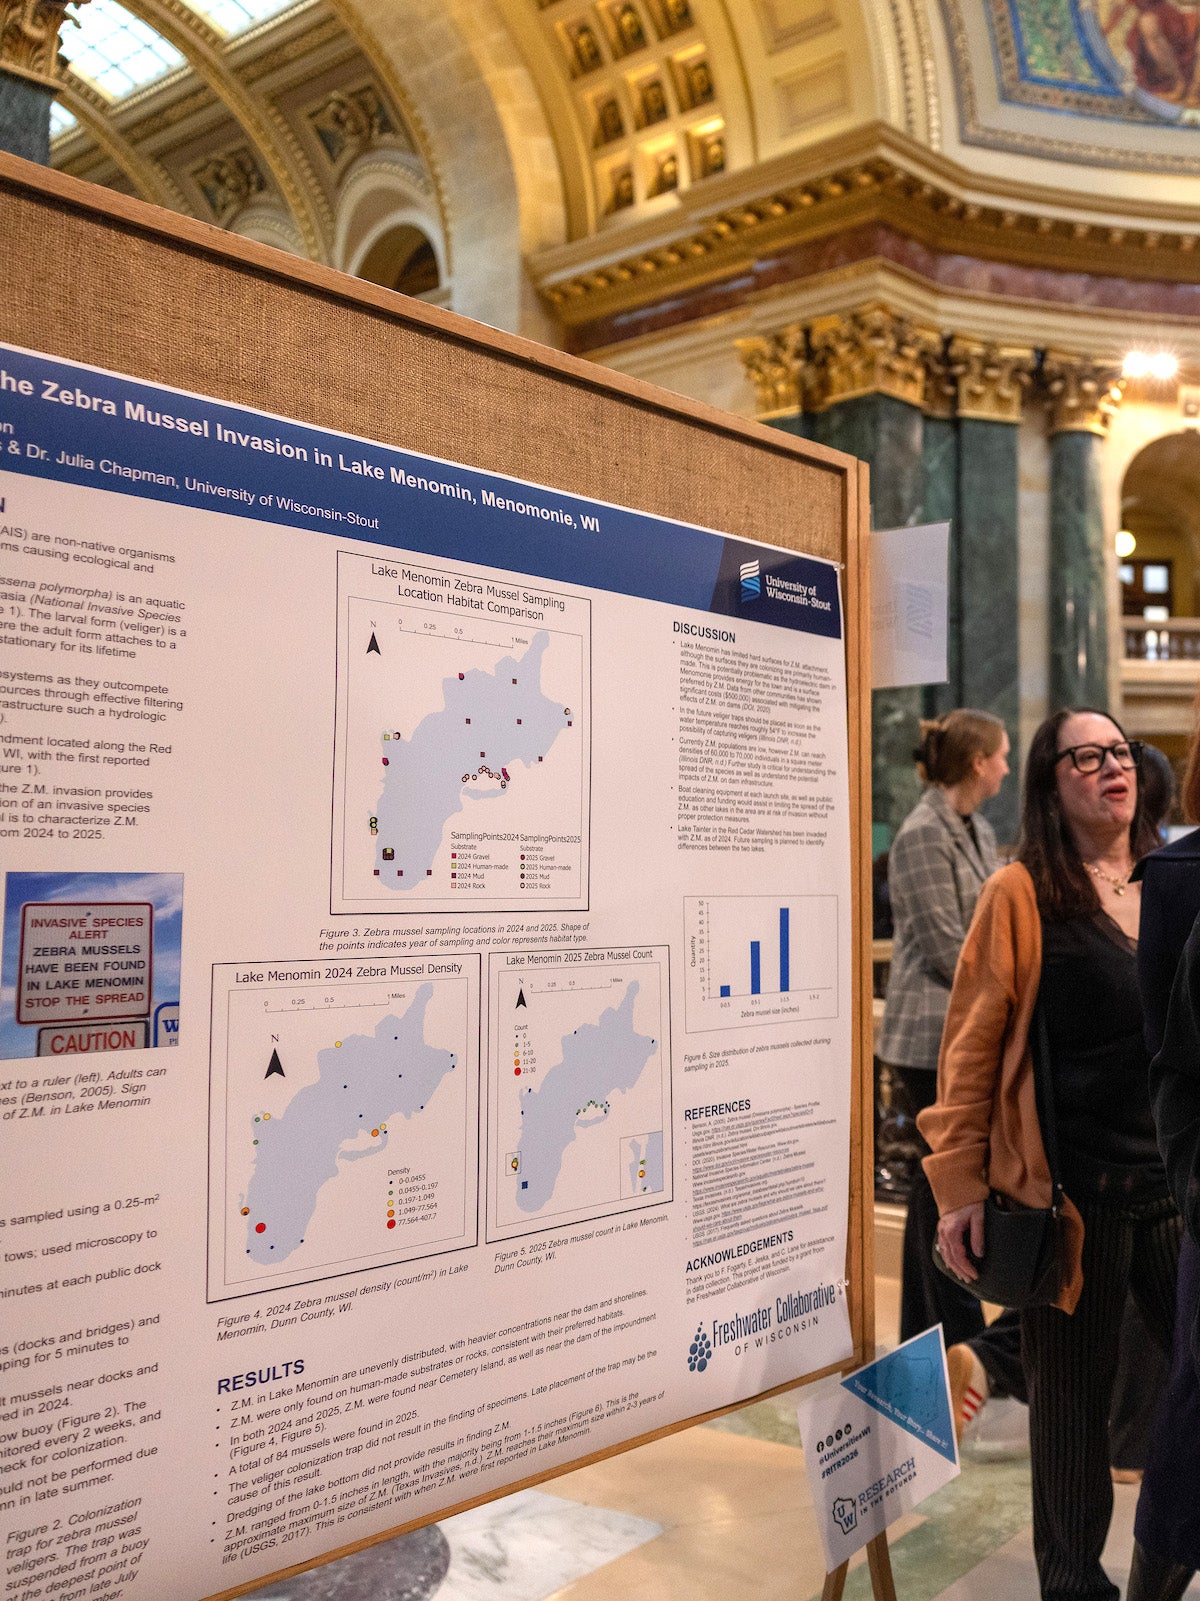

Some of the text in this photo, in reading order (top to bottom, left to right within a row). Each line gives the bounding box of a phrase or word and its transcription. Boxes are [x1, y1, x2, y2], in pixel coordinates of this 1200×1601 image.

[0, 370, 600, 532] he Zebra Mussel Invasion in Lake Menomin, Menomonie, WI
[8, 440, 379, 530] & Dr. Julia Chapman, University of Wisconsin-Stout
[23, 545, 154, 573] causing ecological and
[32, 533, 175, 563] are non-native organisms
[371, 563, 565, 612] Lake Menomin Zebra Mussel Sampling
[765, 575, 816, 595] University of
[398, 585, 544, 621] Location Habitat Comparison
[766, 587, 831, 611] Wisconsin-Stout
[673, 621, 736, 643] DISCUSSION
[451, 832, 519, 842] SamplingPoints2024
[520, 833, 581, 844] SamplingPoints2025
[31, 918, 143, 928] INVASIVE SPECIES
[69, 930, 108, 939] ALERT
[319, 929, 349, 940] Figure
[351, 928, 360, 937] 3.
[364, 927, 390, 937] Zebra
[392, 926, 423, 936] mussel
[425, 926, 461, 936] sampling
[462, 925, 496, 934] locations
[526, 924, 539, 932] and
[541, 923, 558, 932] 2025.
[561, 923, 580, 932] Shape
[582, 922, 590, 930] of
[33, 945, 140, 957] ZEBRA MUSSELS
[319, 941, 335, 951] the
[337, 940, 365, 951] points
[368, 939, 407, 948] indicates
[409, 939, 427, 949] year
[428, 938, 438, 946] of
[440, 937, 474, 948] sampling
[476, 937, 491, 945] and
[511, 935, 547, 945] represents
[550, 934, 571, 942] habitat
[573, 934, 588, 943] type.
[26, 961, 145, 973] HAVE BEEN FOUND
[506, 950, 653, 965] Lake Menomin 2025 Zebra Mussel Count
[27, 977, 144, 990] IN LAKE MENOMIN
[236, 963, 462, 983] Lake Menomin 2024 Zebra Mussel Density
[25, 993, 144, 1008] STOP THE SPREAD
[51, 1030, 135, 1054] CAUTION
[684, 1099, 750, 1121] REFERENCES
[387, 1167, 410, 1177] Density
[686, 1231, 793, 1273] ACKNOWLEDGEMENTS
[217, 1313, 250, 1327] Figure
[254, 1310, 263, 1318] 4.
[267, 1303, 291, 1317] 2024
[294, 1298, 322, 1311] Zebra
[324, 1289, 358, 1304] mussel
[360, 1281, 393, 1296] density
[439, 1269, 447, 1277] in
[449, 1264, 468, 1275] Lake
[217, 1302, 353, 1341] Menomin, Dunn County, WI.
[713, 1283, 835, 1348] Freshwater Collaborative
[734, 1316, 819, 1356] OF WISCONSIN
[231, 1289, 647, 1410] Z.M. in Lake Menomin are unevenly distributed, with heavier concentrations near the dam and shorelines.
[218, 1359, 305, 1395] RESULTS
[228, 1466, 237, 1475] A
[239, 1460, 261, 1472] total
[263, 1455, 274, 1465] of
[276, 1450, 288, 1460] 84
[291, 1438, 330, 1457] mussels
[333, 1431, 355, 1443] were
[358, 1422, 383, 1436] found
[395, 1410, 420, 1424] 2025.
[821, 1449, 859, 1479] #RITR2026
[859, 1457, 915, 1506] RESEARCH
[860, 1472, 917, 1516] IN THE ROTUNDA
[837, 1504, 845, 1518] U
[843, 1513, 853, 1528] W
